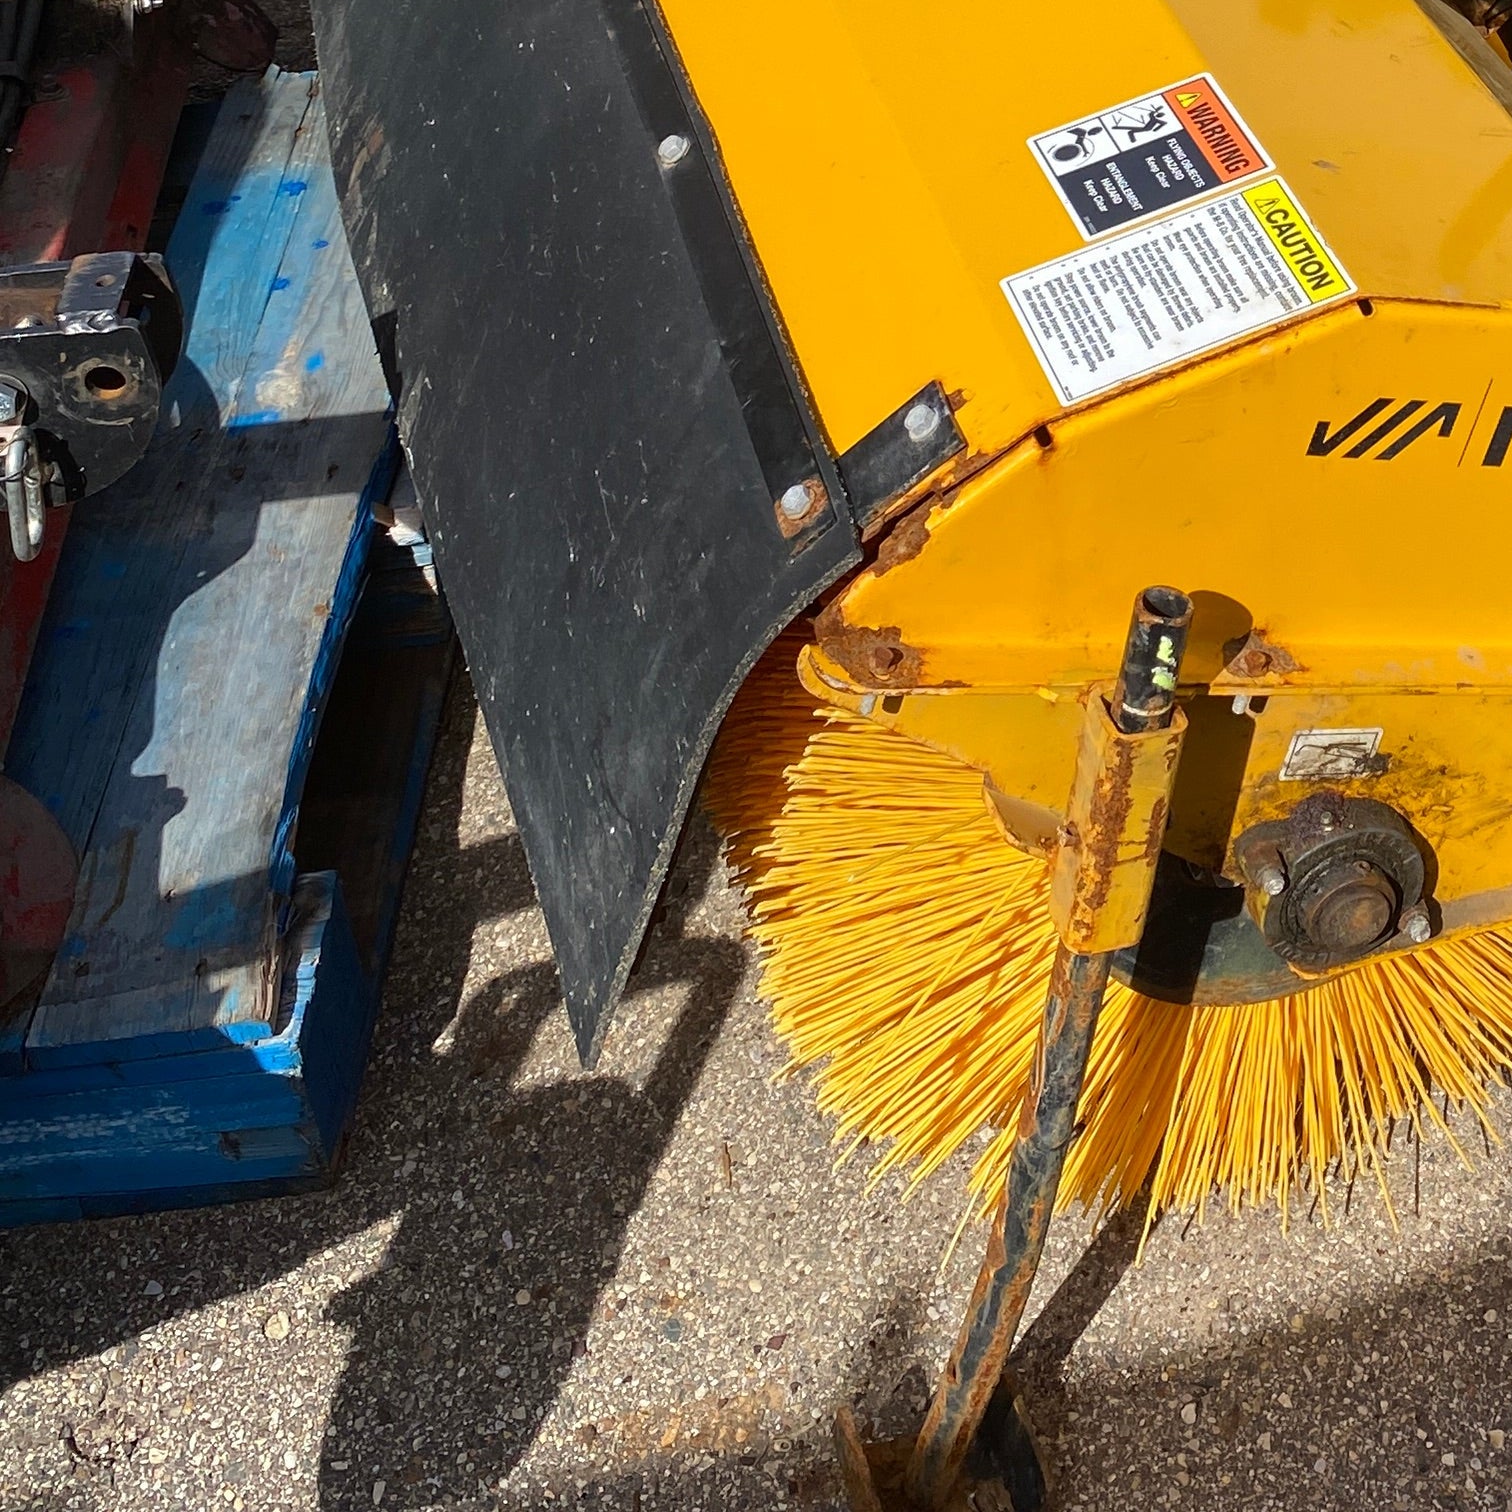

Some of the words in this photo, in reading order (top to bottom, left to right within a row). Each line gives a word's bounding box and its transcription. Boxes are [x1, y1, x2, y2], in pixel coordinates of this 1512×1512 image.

[1186, 101, 1250, 174] WARNING
[1145, 155, 1160, 172] Keep
[1155, 171, 1170, 188] Clear
[1162, 154, 1184, 180] HAZARD
[1166, 138, 1187, 160] FLYING
[1180, 159, 1205, 187] OBJECTS
[1083, 179, 1098, 196] Keep
[1093, 195, 1108, 211] Clear
[1100, 177, 1122, 204] HAZARD
[1105, 161, 1143, 210] ENTANGLEMENT
[1264, 208, 1334, 291] CAUTION
